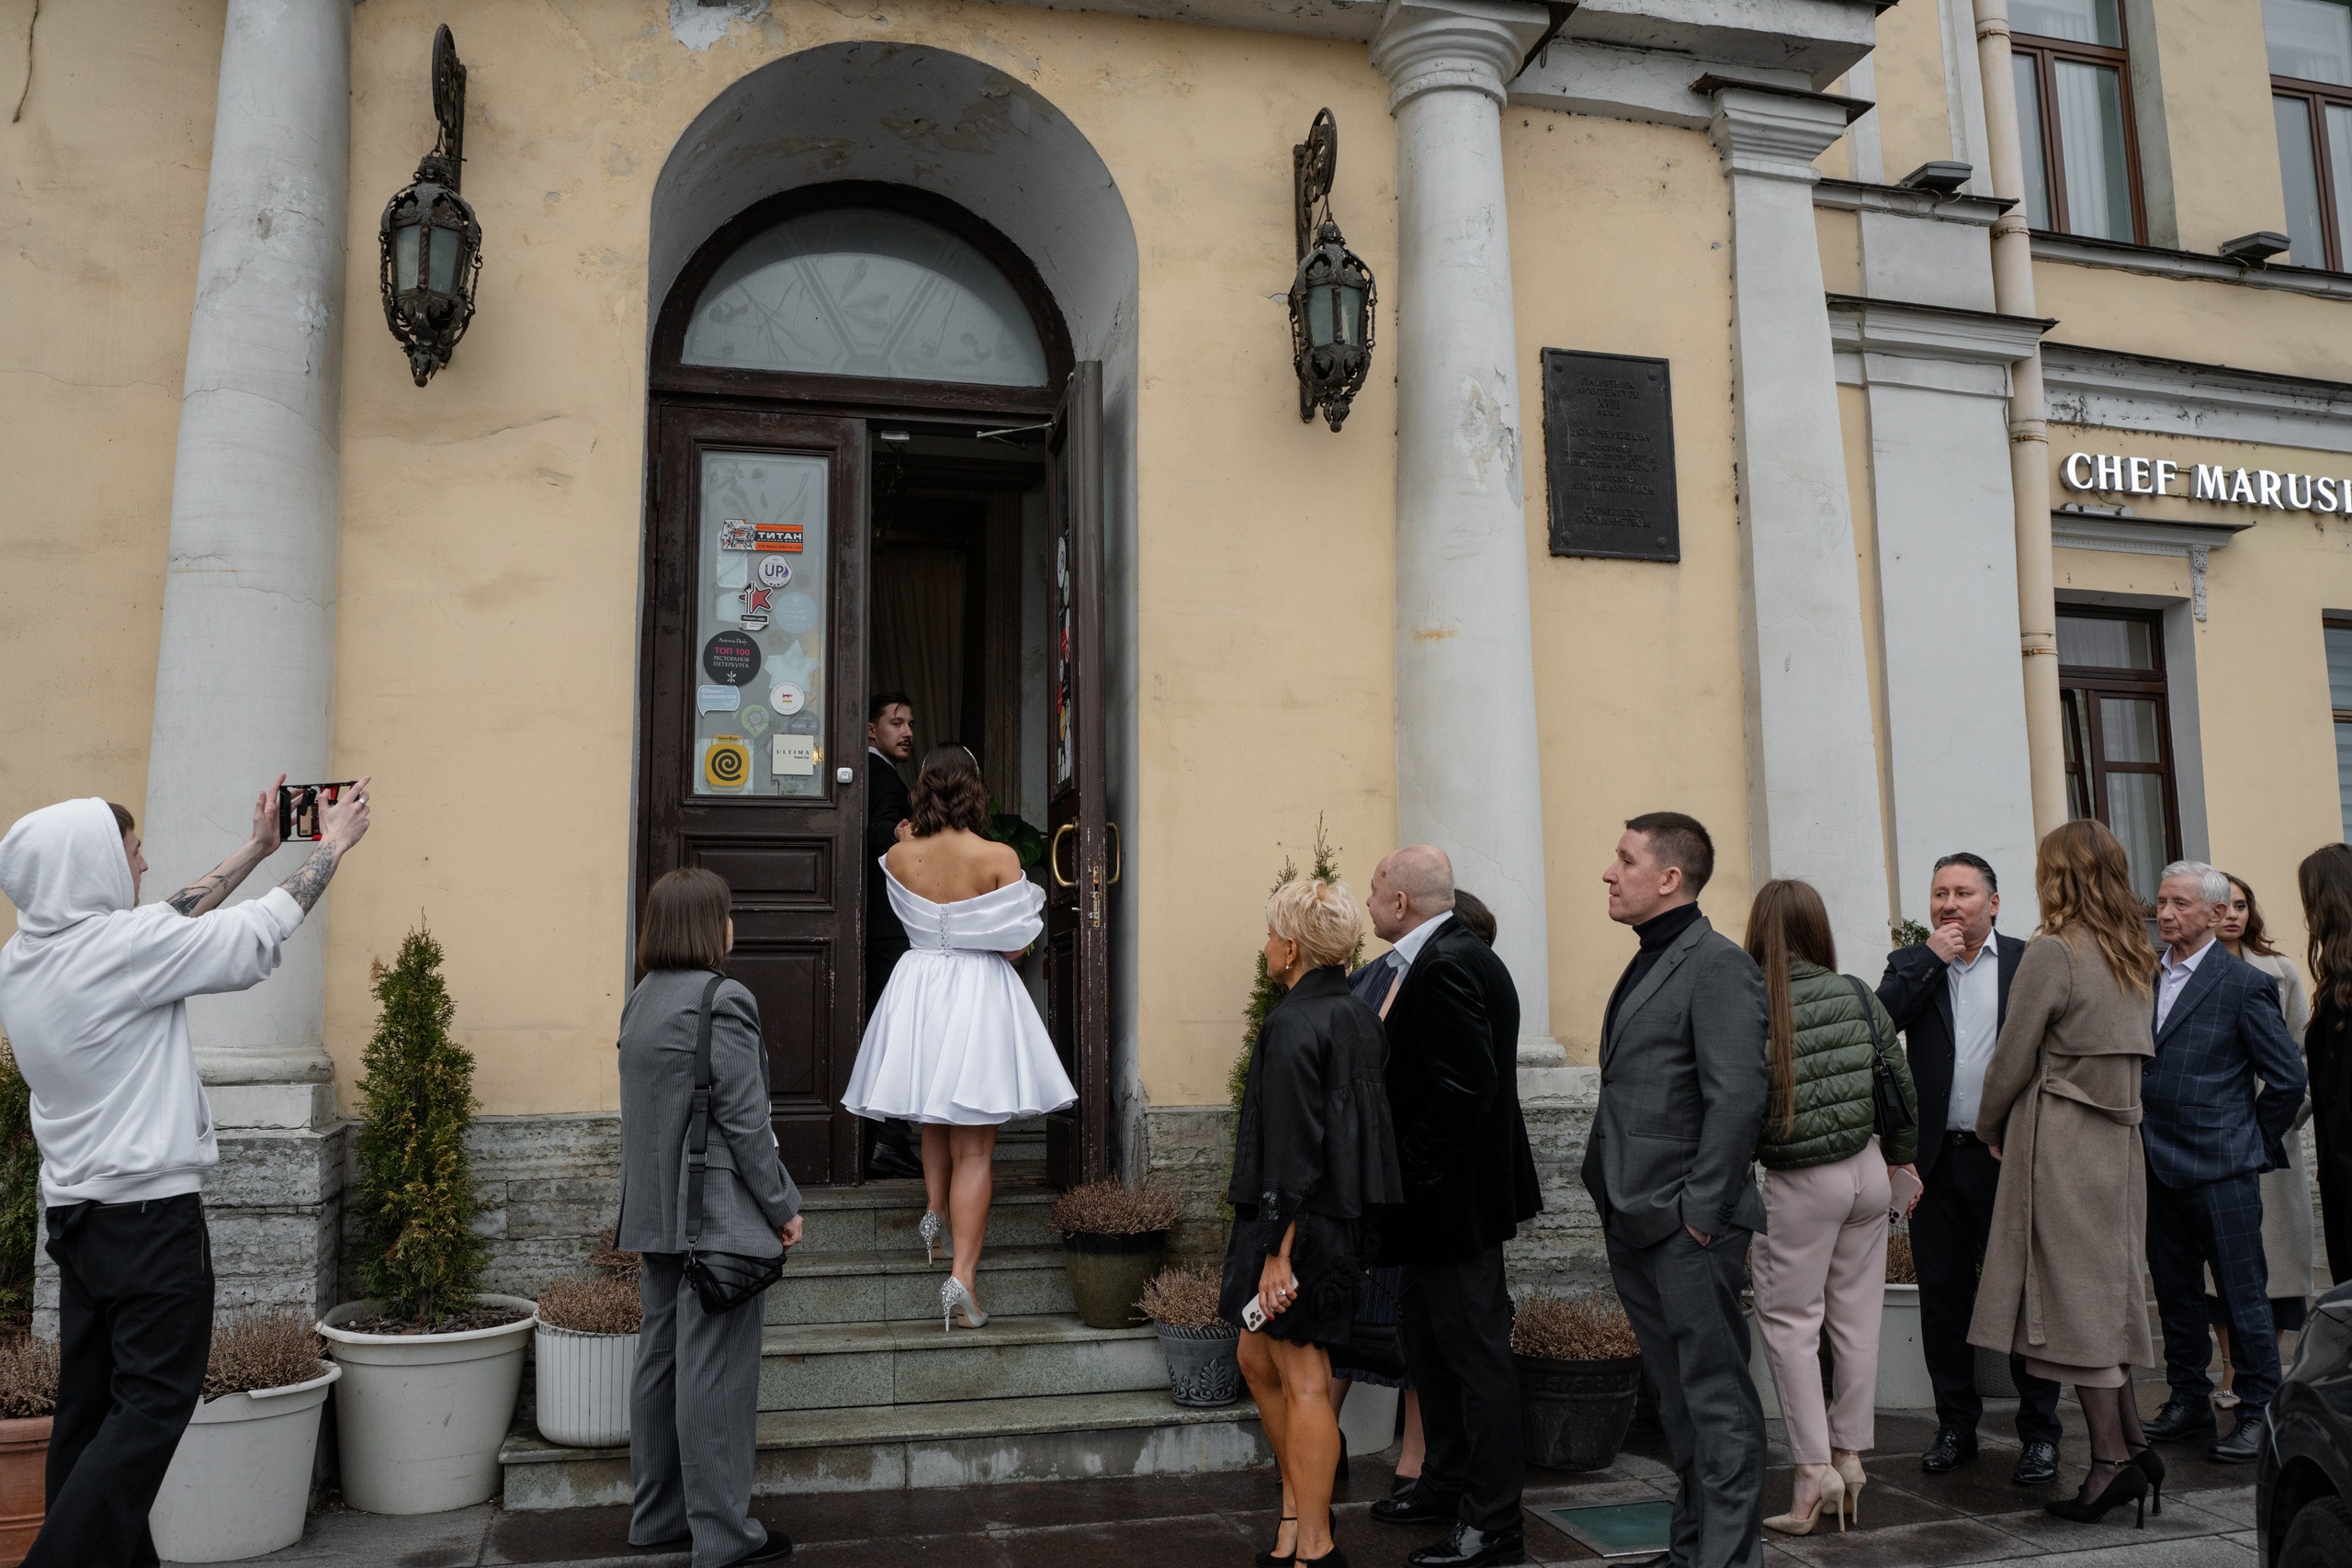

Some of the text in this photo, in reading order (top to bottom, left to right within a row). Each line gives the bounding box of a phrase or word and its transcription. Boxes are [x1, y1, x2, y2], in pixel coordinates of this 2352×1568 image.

[2064, 451, 2178, 496] CHEF
[757, 531, 802, 540] ТИТАН
[764, 564, 785, 578] UP
[714, 646, 751, 657] ТОП 100
[713, 655, 750, 663] РЕСТОРАНОВ
[713, 660, 750, 669] ПЕТЕРБУРГА
